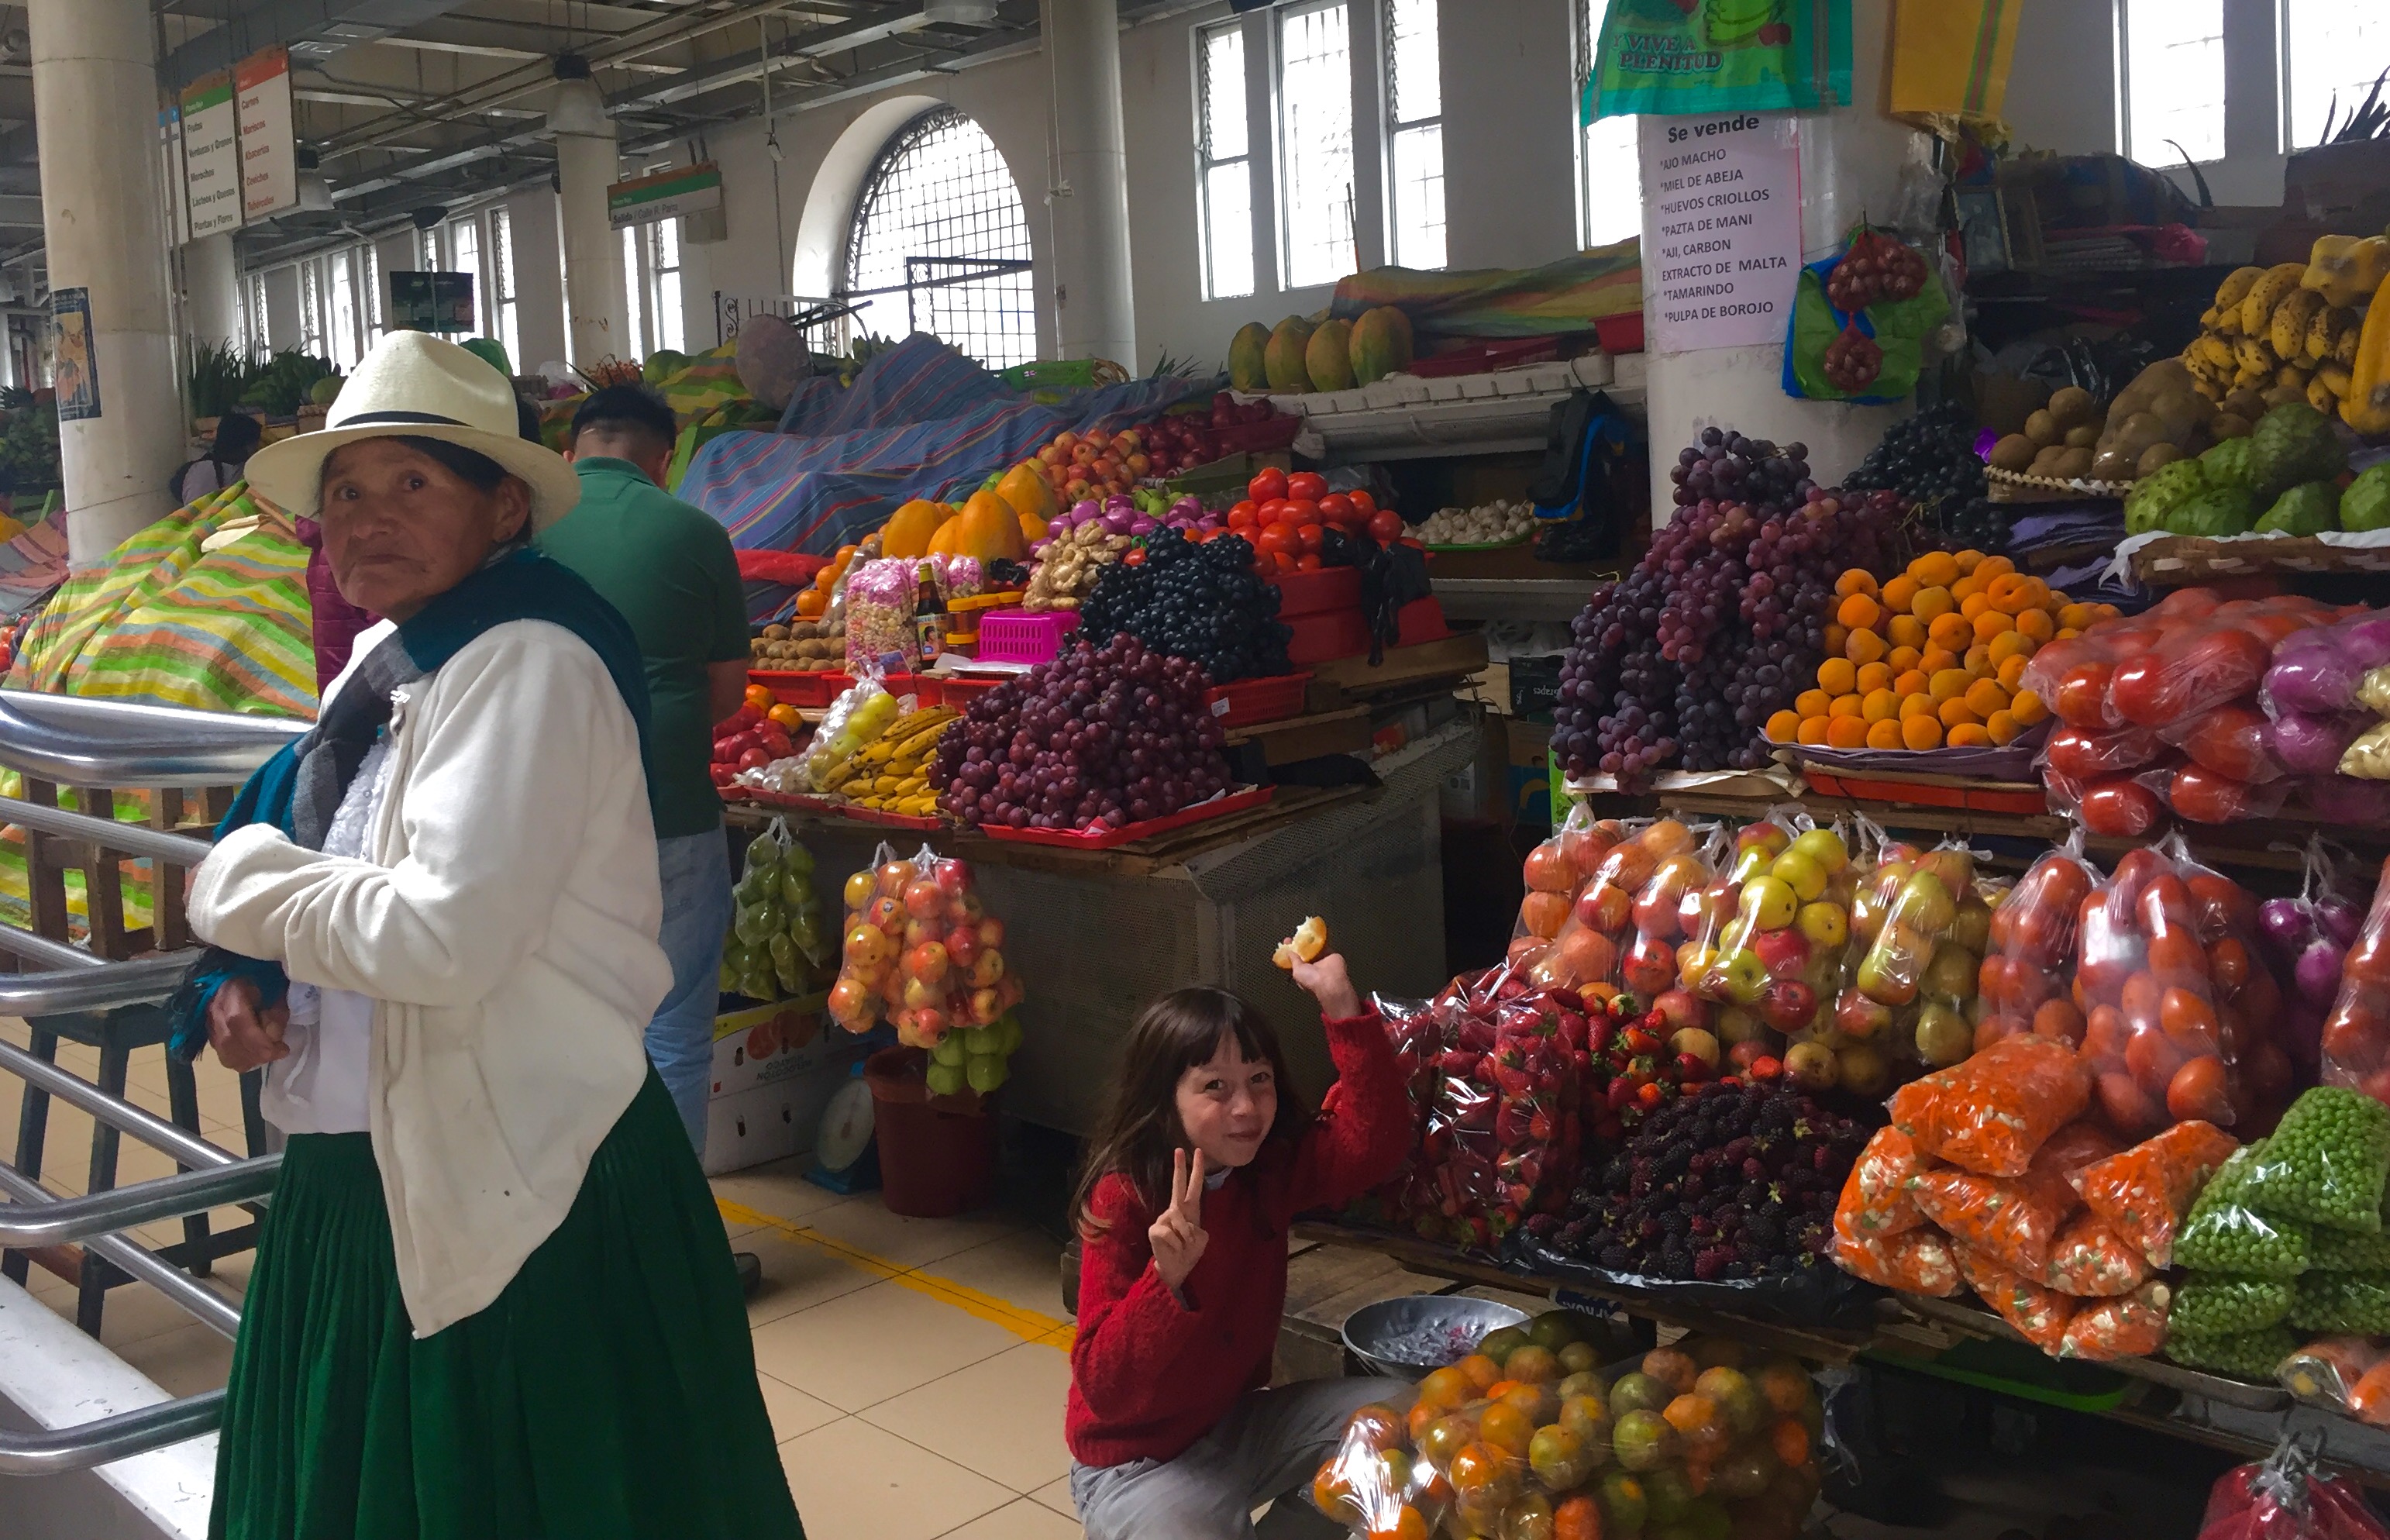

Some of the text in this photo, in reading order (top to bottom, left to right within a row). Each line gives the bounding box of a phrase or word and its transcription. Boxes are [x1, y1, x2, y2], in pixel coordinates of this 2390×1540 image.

[1627, 33, 1679, 51] VIVE
[1684, 36, 1697, 51] A
[1620, 51, 1722, 71] PLENITUD
[242, 97, 260, 110] Carnes
[188, 122, 203, 134] Frutas
[243, 120, 266, 135] Mariscos
[1668, 114, 1760, 143] Se vende
[189, 137, 232, 158] Verduras y Granos
[1681, 149, 1727, 167] MACHO
[1687, 174, 1702, 188] DE
[1705, 169, 1744, 186] ABEJA
[217, 188, 236, 200] Quesos
[1707, 189, 1770, 207] CRIOLLOS
[195, 221, 213, 232] Plantas
[218, 215, 233, 225] Flores
[614, 213, 633, 224] Salida
[639, 208, 653, 219] Calle
[1697, 218, 1713, 231] DE
[1716, 214, 1752, 228] MANI
[1683, 239, 1731, 257] CARBON
[1662, 256, 1787, 282] EXTRACTO DE MALTA
[1701, 305, 1716, 319] DE
[1720, 301, 1773, 318] BOROJO
